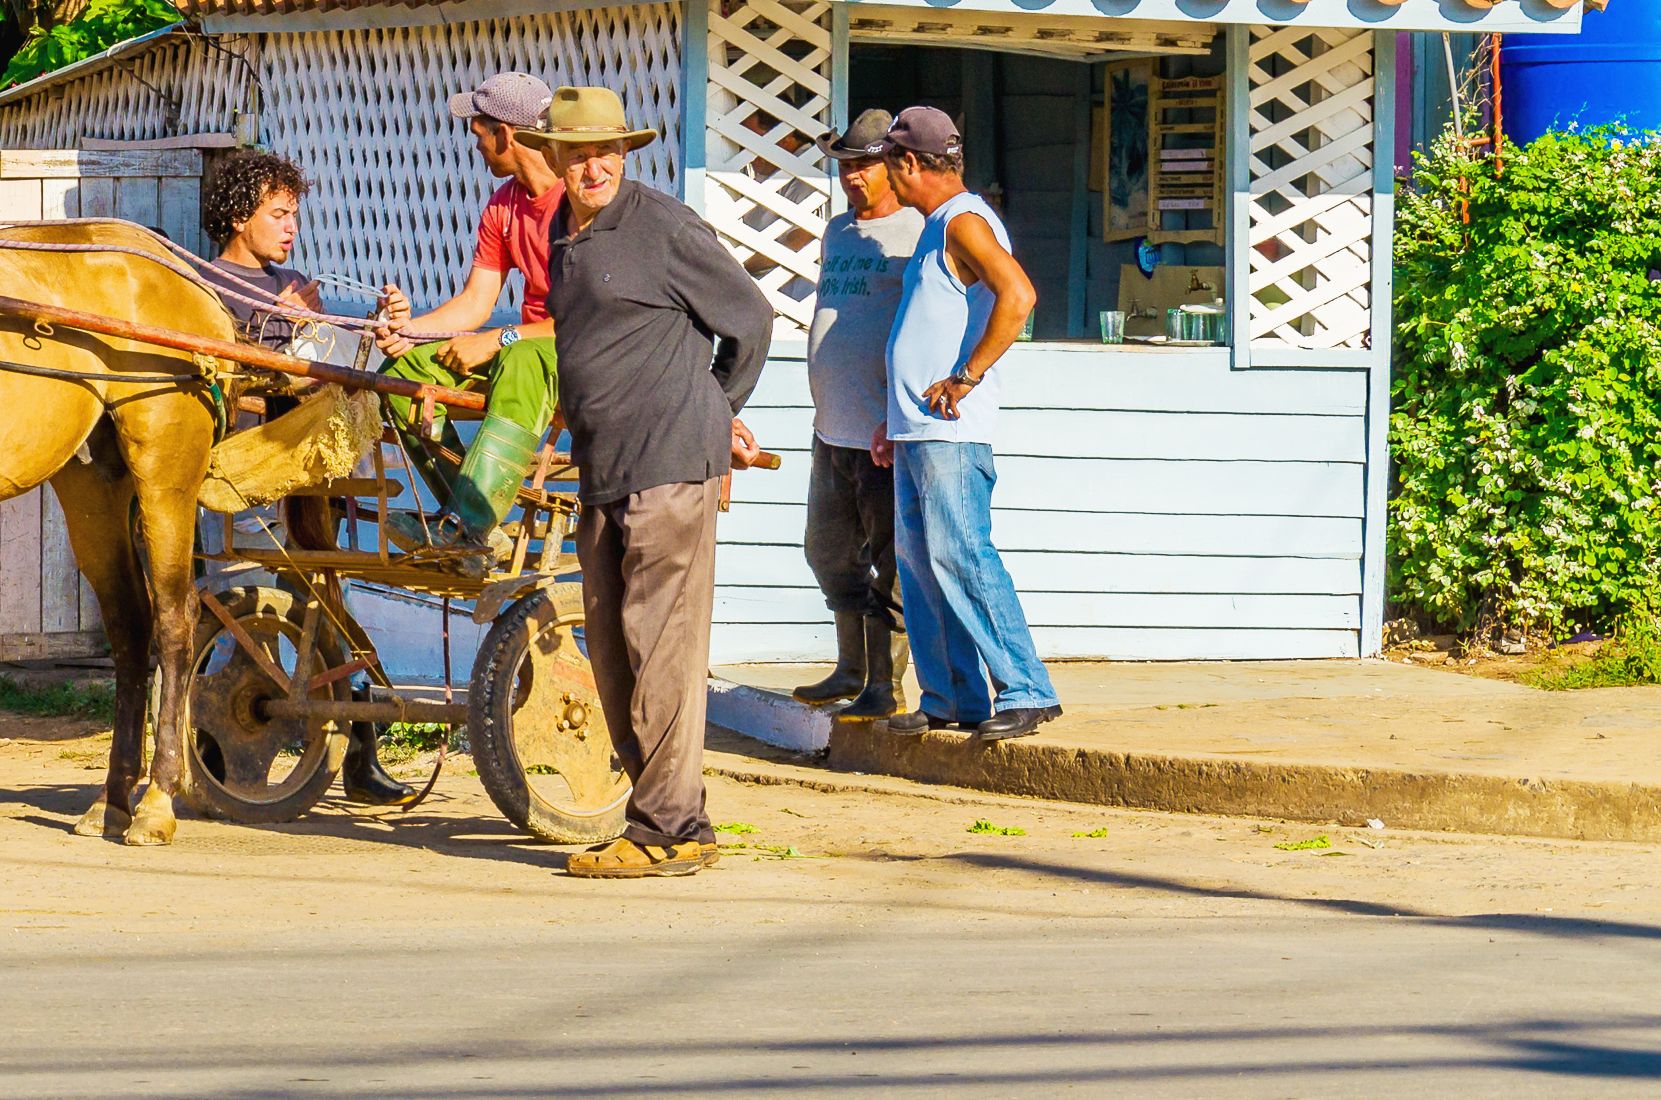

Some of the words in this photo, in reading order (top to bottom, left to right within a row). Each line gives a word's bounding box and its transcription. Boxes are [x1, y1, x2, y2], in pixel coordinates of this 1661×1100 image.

[840, 254, 855, 273] of
[853, 257, 873, 272] me
[876, 254, 888, 272] is
[841, 275, 871, 296] Irish.
